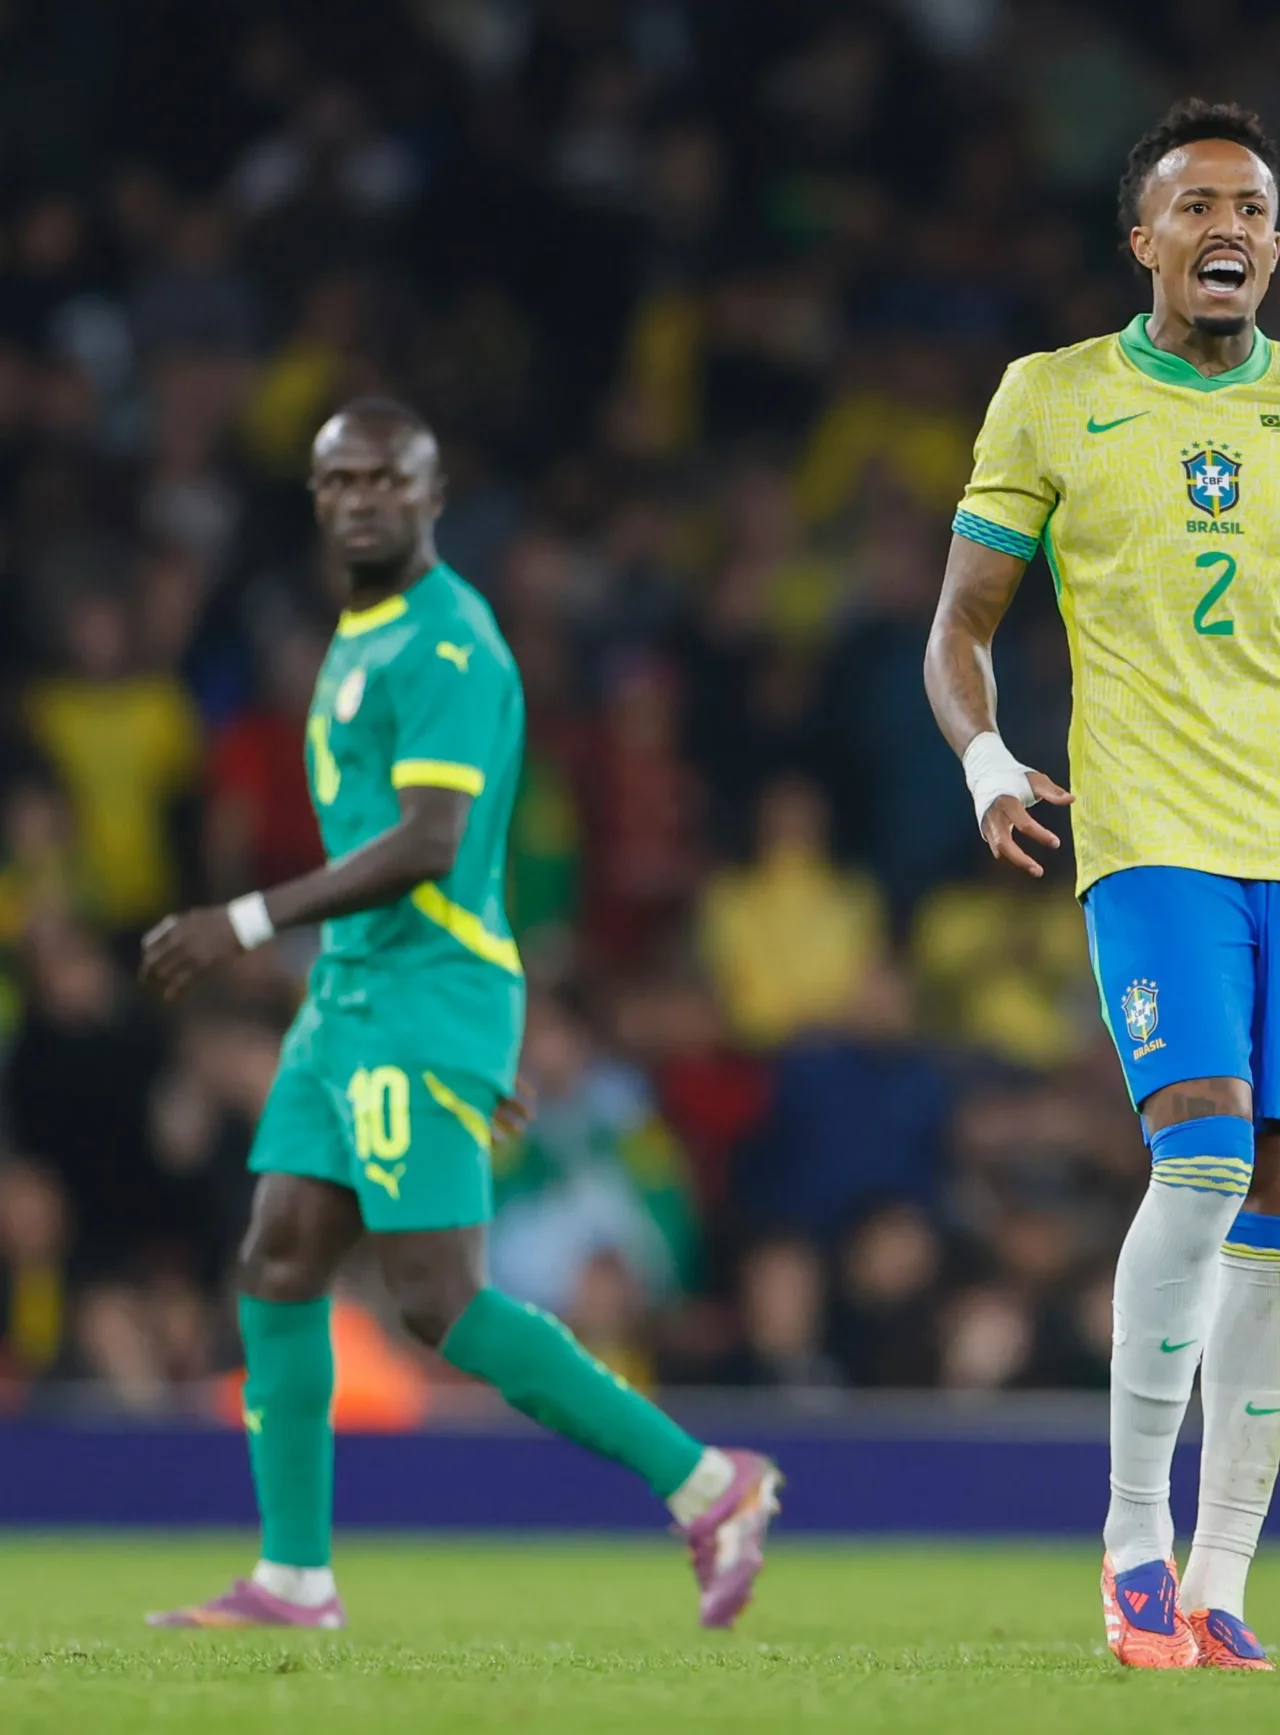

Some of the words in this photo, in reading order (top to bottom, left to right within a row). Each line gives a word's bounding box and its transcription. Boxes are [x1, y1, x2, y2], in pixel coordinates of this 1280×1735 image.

[1202, 476, 1224, 485] CBF
[1186, 520, 1246, 535] BRASIL
[1193, 551, 1237, 635] 2
[1133, 1038, 1167, 1060] BRASIL
[347, 1065, 411, 1161] 10
